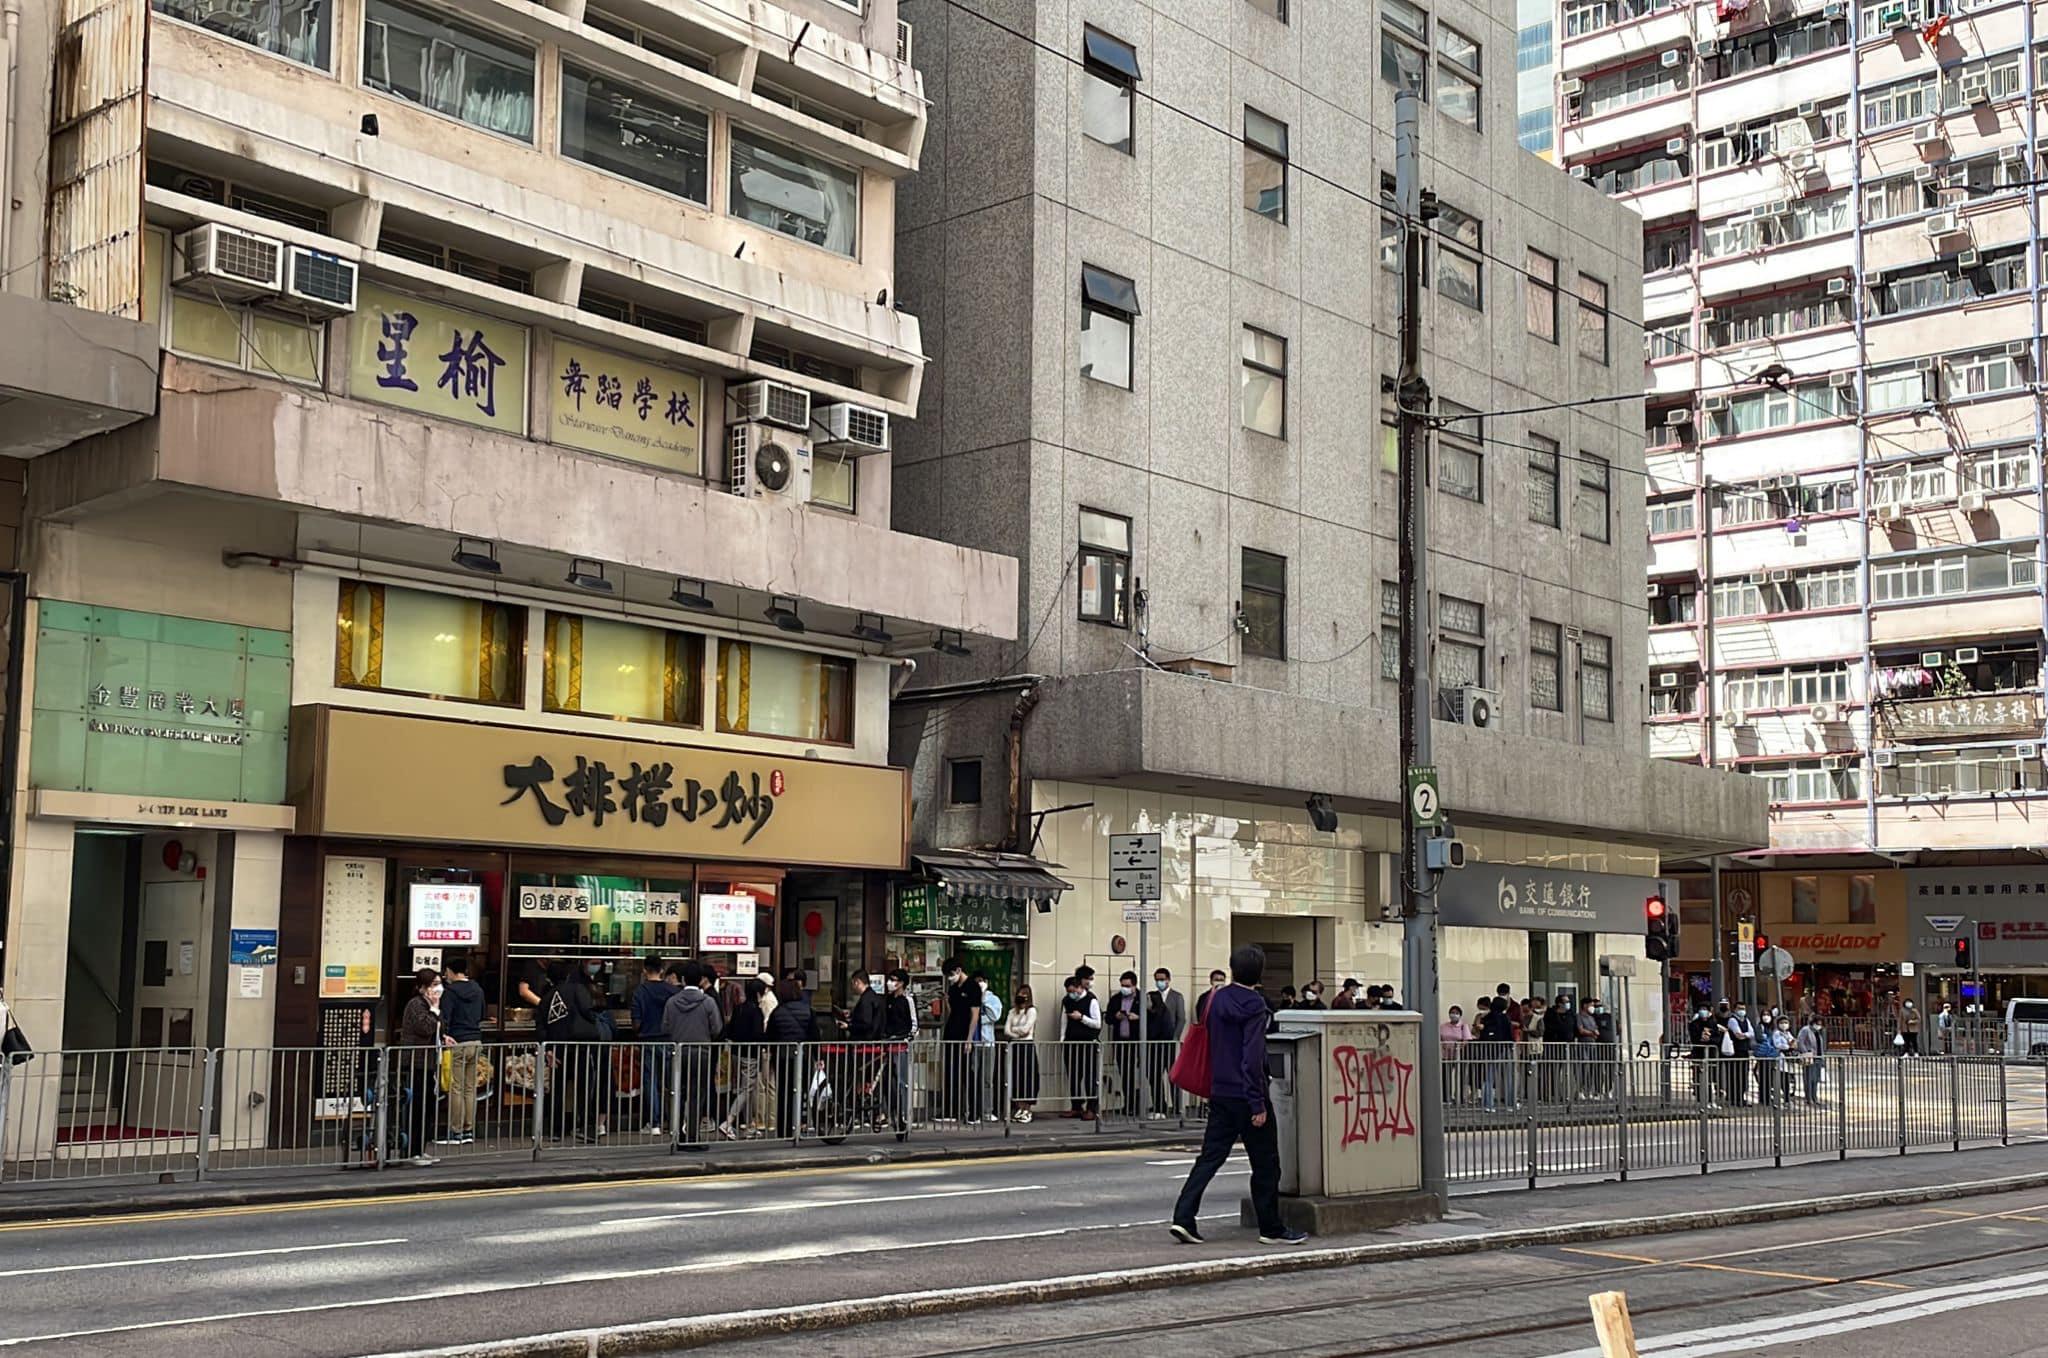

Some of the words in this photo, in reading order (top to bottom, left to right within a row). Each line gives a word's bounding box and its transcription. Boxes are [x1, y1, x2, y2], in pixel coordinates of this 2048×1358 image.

[376, 312, 506, 417] 星榆
[560, 358, 696, 428] 舞蹈學校
[500, 756, 774, 845] 大排檔小炒
[1419, 789, 1432, 812] 2
[1140, 872, 1153, 880] Bus
[1135, 883, 1155, 895] 巴士
[1524, 879, 1592, 909] 交通銀行
[522, 892, 589, 913] 回饋顧客
[617, 898, 680, 917] 共同抗疫
[1518, 906, 1535, 915] BANK
[1537, 908, 1546, 916] OF
[1547, 909, 1597, 920] COMMUNICATIONS
[936, 911, 993, 931] 柯式印刷
